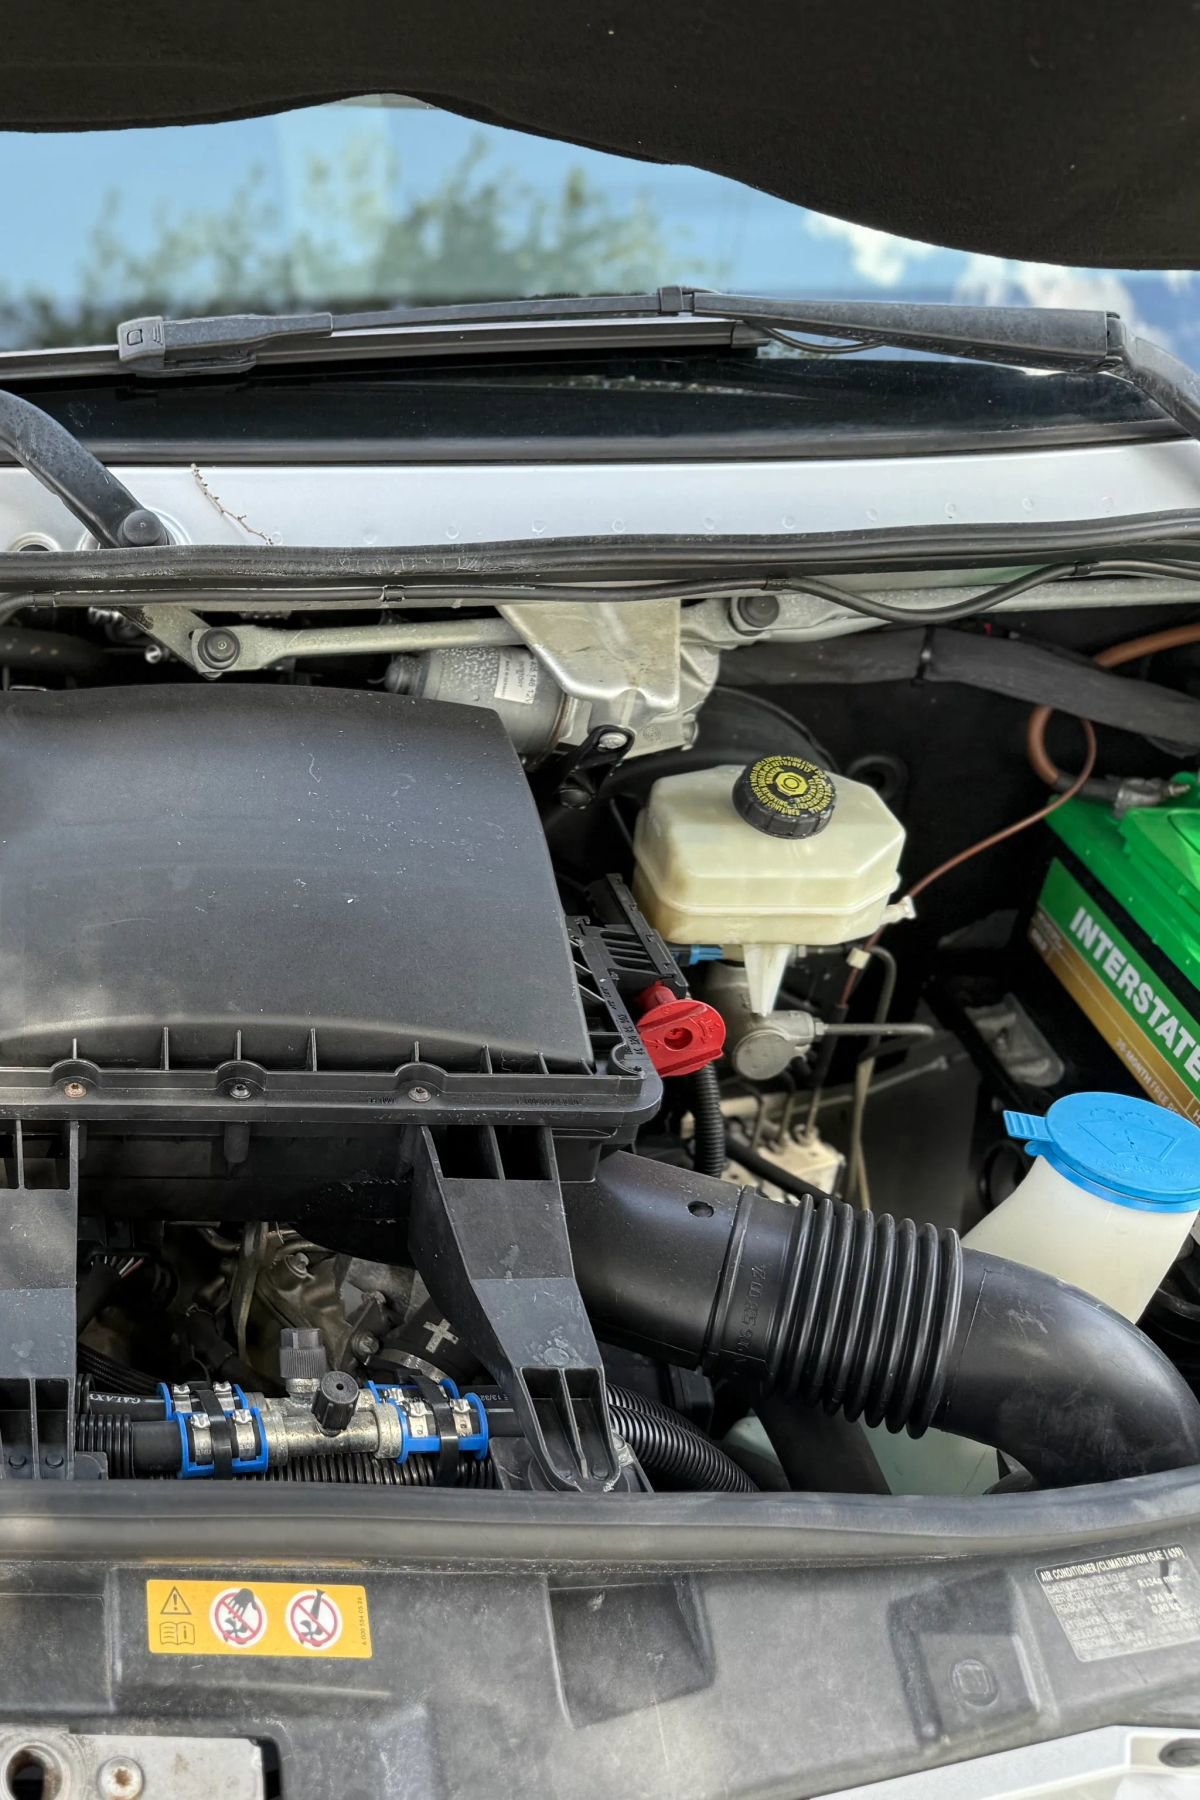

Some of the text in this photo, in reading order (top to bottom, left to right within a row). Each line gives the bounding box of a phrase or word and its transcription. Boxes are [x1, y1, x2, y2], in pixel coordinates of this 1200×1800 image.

[1039, 1570, 1053, 1580] AIR
[1051, 1553, 1148, 1578] CONDITIONER/CLIMATISATION
[1147, 1550, 1164, 1561] (SAE
[1167, 1547, 1184, 1558] 639)
